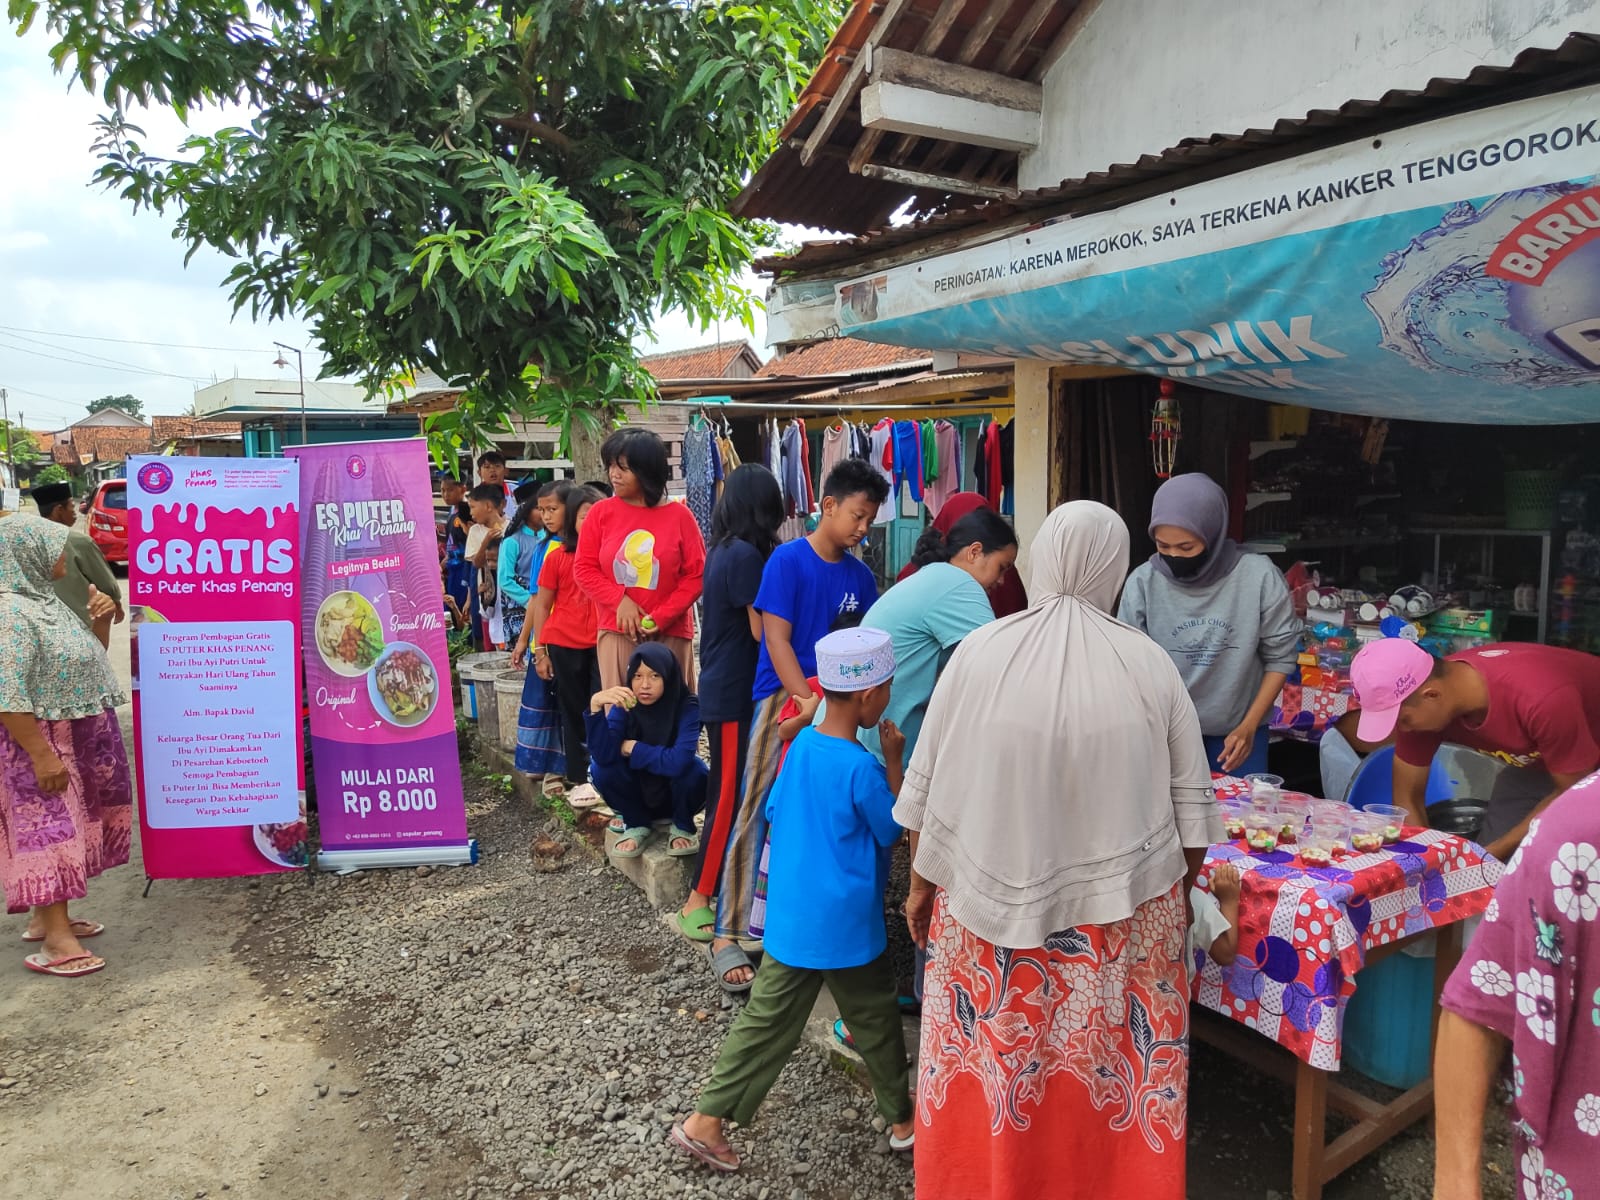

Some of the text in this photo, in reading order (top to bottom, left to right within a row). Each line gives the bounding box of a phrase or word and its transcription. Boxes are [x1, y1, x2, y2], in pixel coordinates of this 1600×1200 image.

[934, 119, 1600, 293] PERINGATAN: KARENA MEROKOK, SAYA TERKENA KANKER TENGGOROK
[1499, 196, 1600, 278] BARU
[190, 469, 211, 479] Khas
[185, 478, 217, 488] Penang
[315, 499, 405, 530] ES PUTER
[329, 518, 417, 547] Khas Penang
[136, 538, 294, 575] GRATIS
[331, 556, 401, 576] Legitnya Beda!!
[137, 579, 294, 598] Es Puter Khas Penang
[390, 614, 420, 632] Special
[1171, 618, 1207, 639] SENSIBLE
[162, 631, 271, 643] Program Pembagian Gratis
[159, 644, 274, 655] ES PUTER KHAS PENANG
[168, 656, 266, 668] Dari Ibu Ayi Putri Untuk
[158, 669, 276, 681] Merayakan Hari Ulang Tahun
[199, 683, 238, 693] Suaminya
[316, 686, 357, 711] Original
[205, 708, 229, 718] Bapak
[231, 707, 254, 716] David
[157, 731, 281, 745] Keluarga Besar Orang Tua Dari
[178, 744, 262, 755] Ibu Ayi Dimakamkan
[172, 760, 182, 768] Di
[182, 770, 260, 781] Semoga Pembagian
[340, 767, 435, 786] MULAI DARI
[162, 780, 281, 792] Es Puter Ini Bisa Memberikan
[165, 793, 279, 806] Kesegaran Dan Kebahagiaan
[342, 788, 437, 819] Rp 8.000
[196, 806, 250, 817] Warga Sekitar
